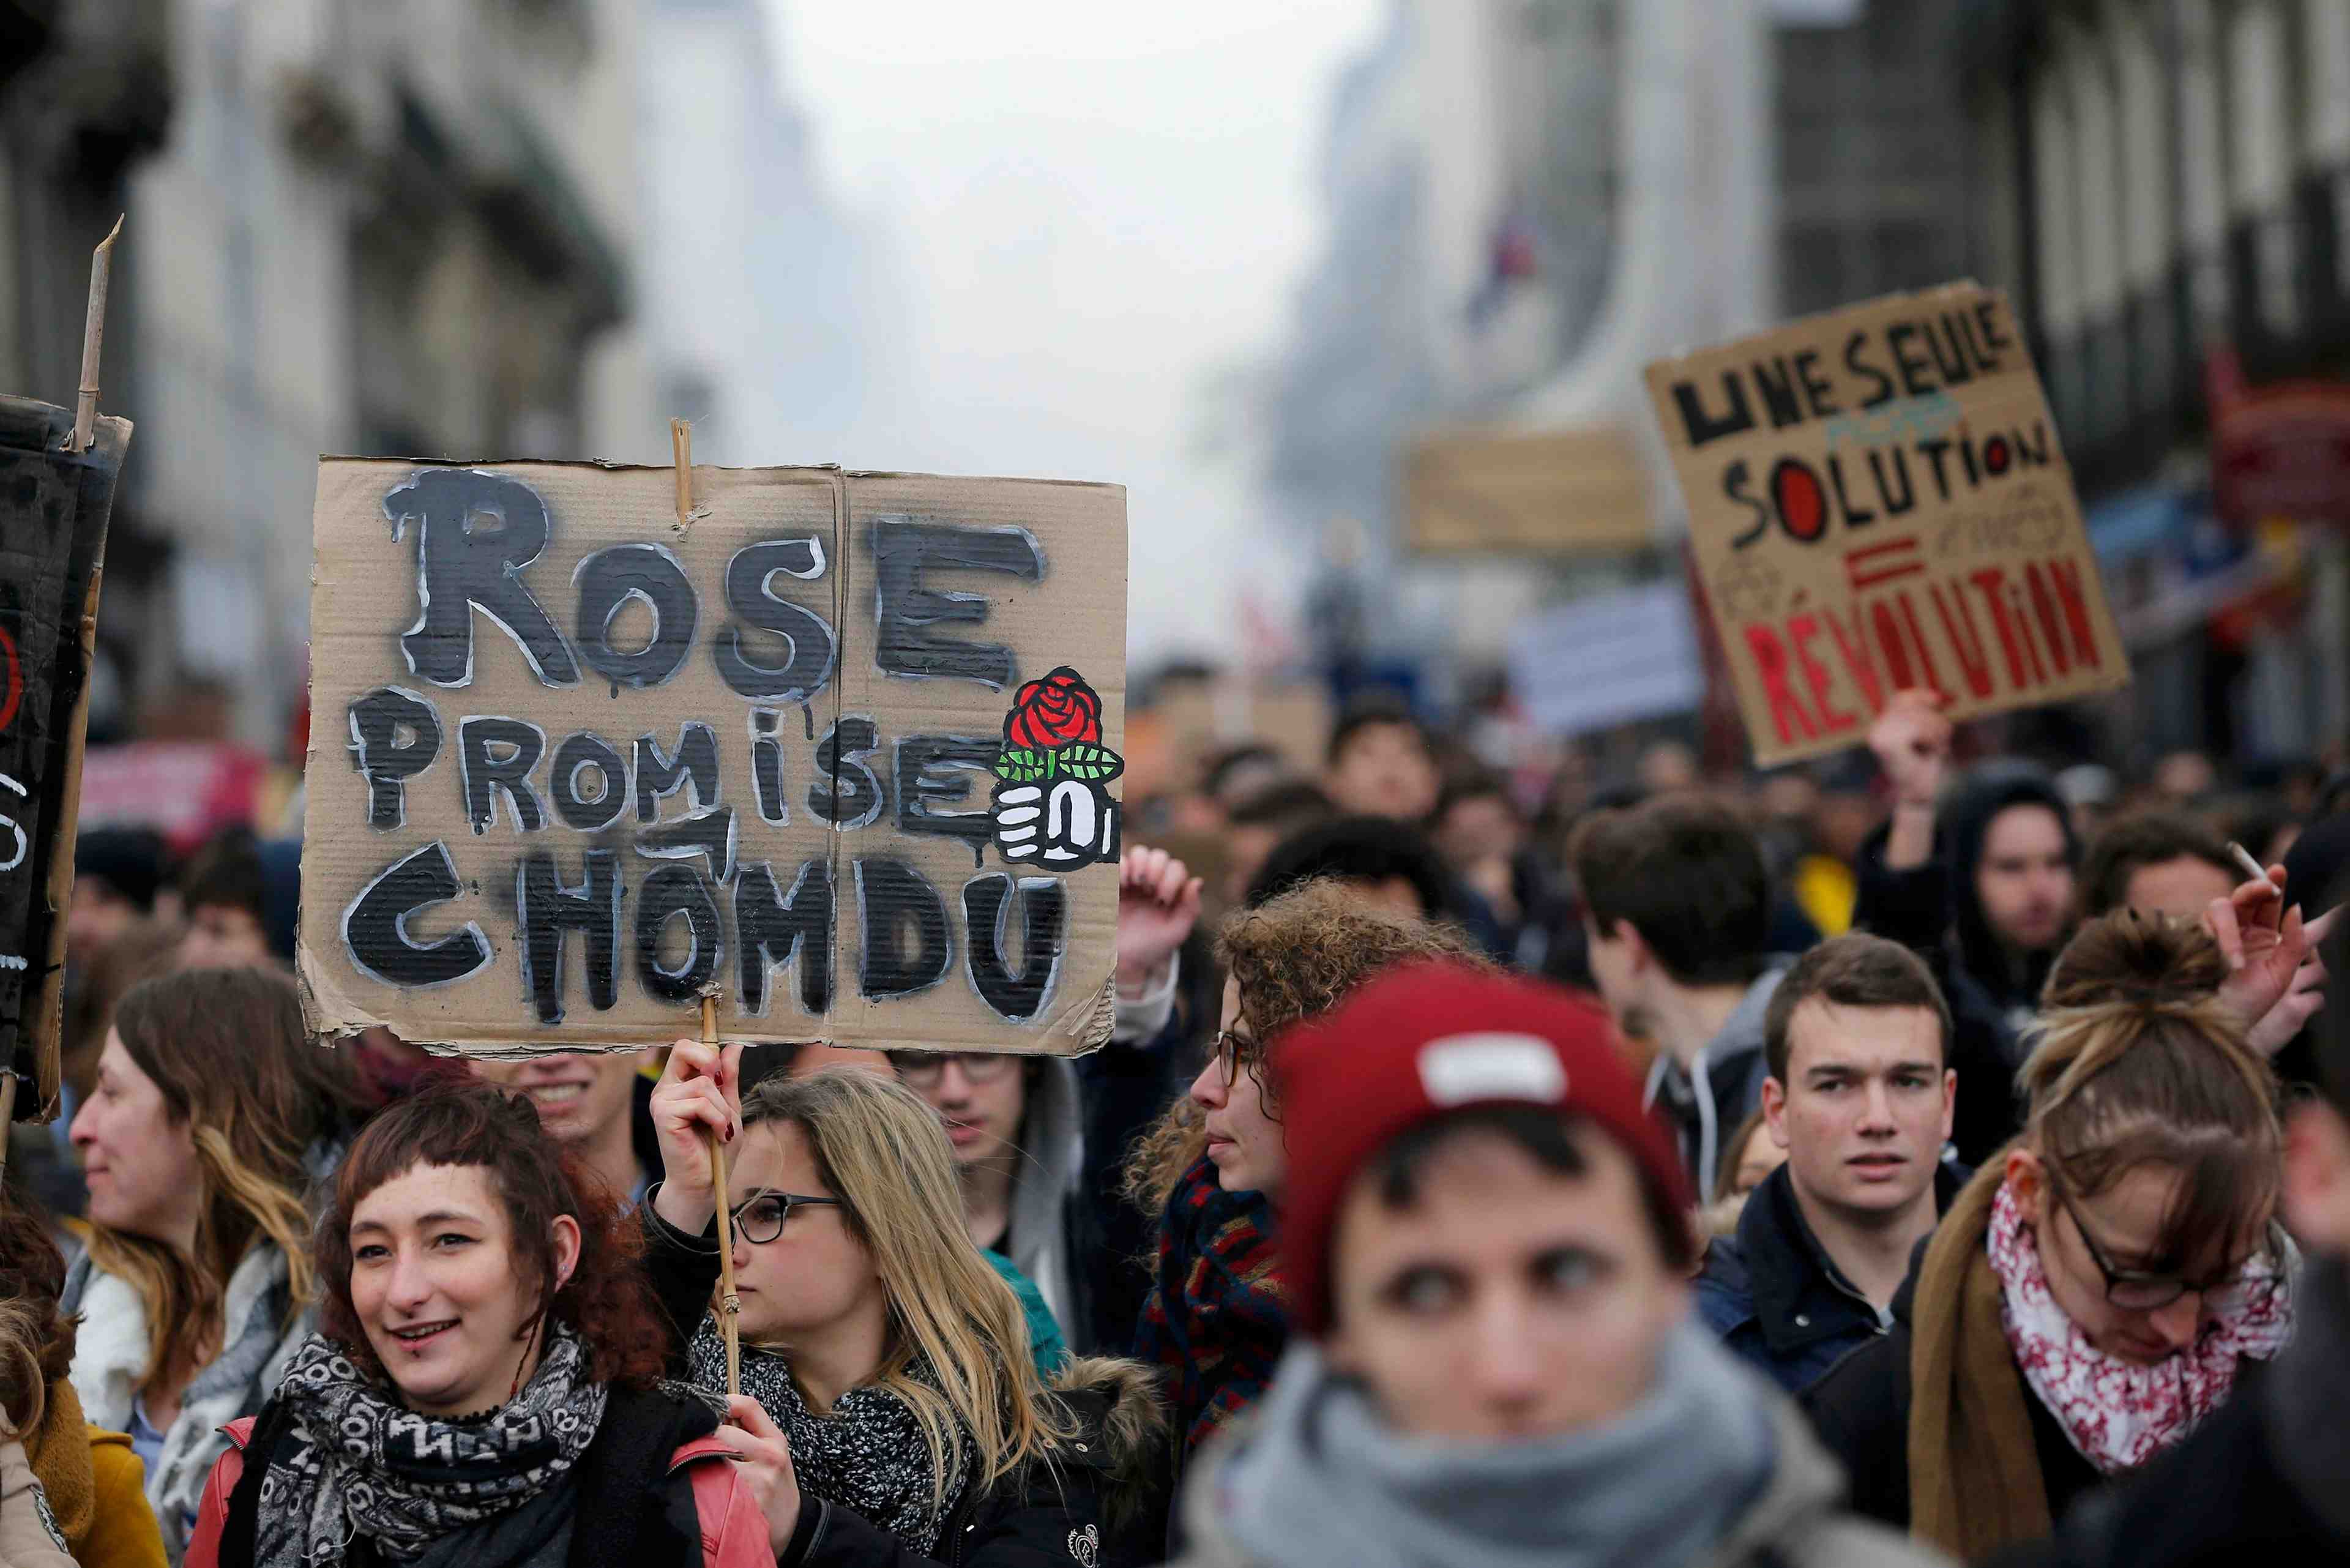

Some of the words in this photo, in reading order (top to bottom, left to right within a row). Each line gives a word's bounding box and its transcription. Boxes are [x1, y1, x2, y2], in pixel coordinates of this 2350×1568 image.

[1672, 344, 1840, 449] UNE
[1843, 300, 2015, 411] SEULE
[382, 468, 1048, 704] ROSE
